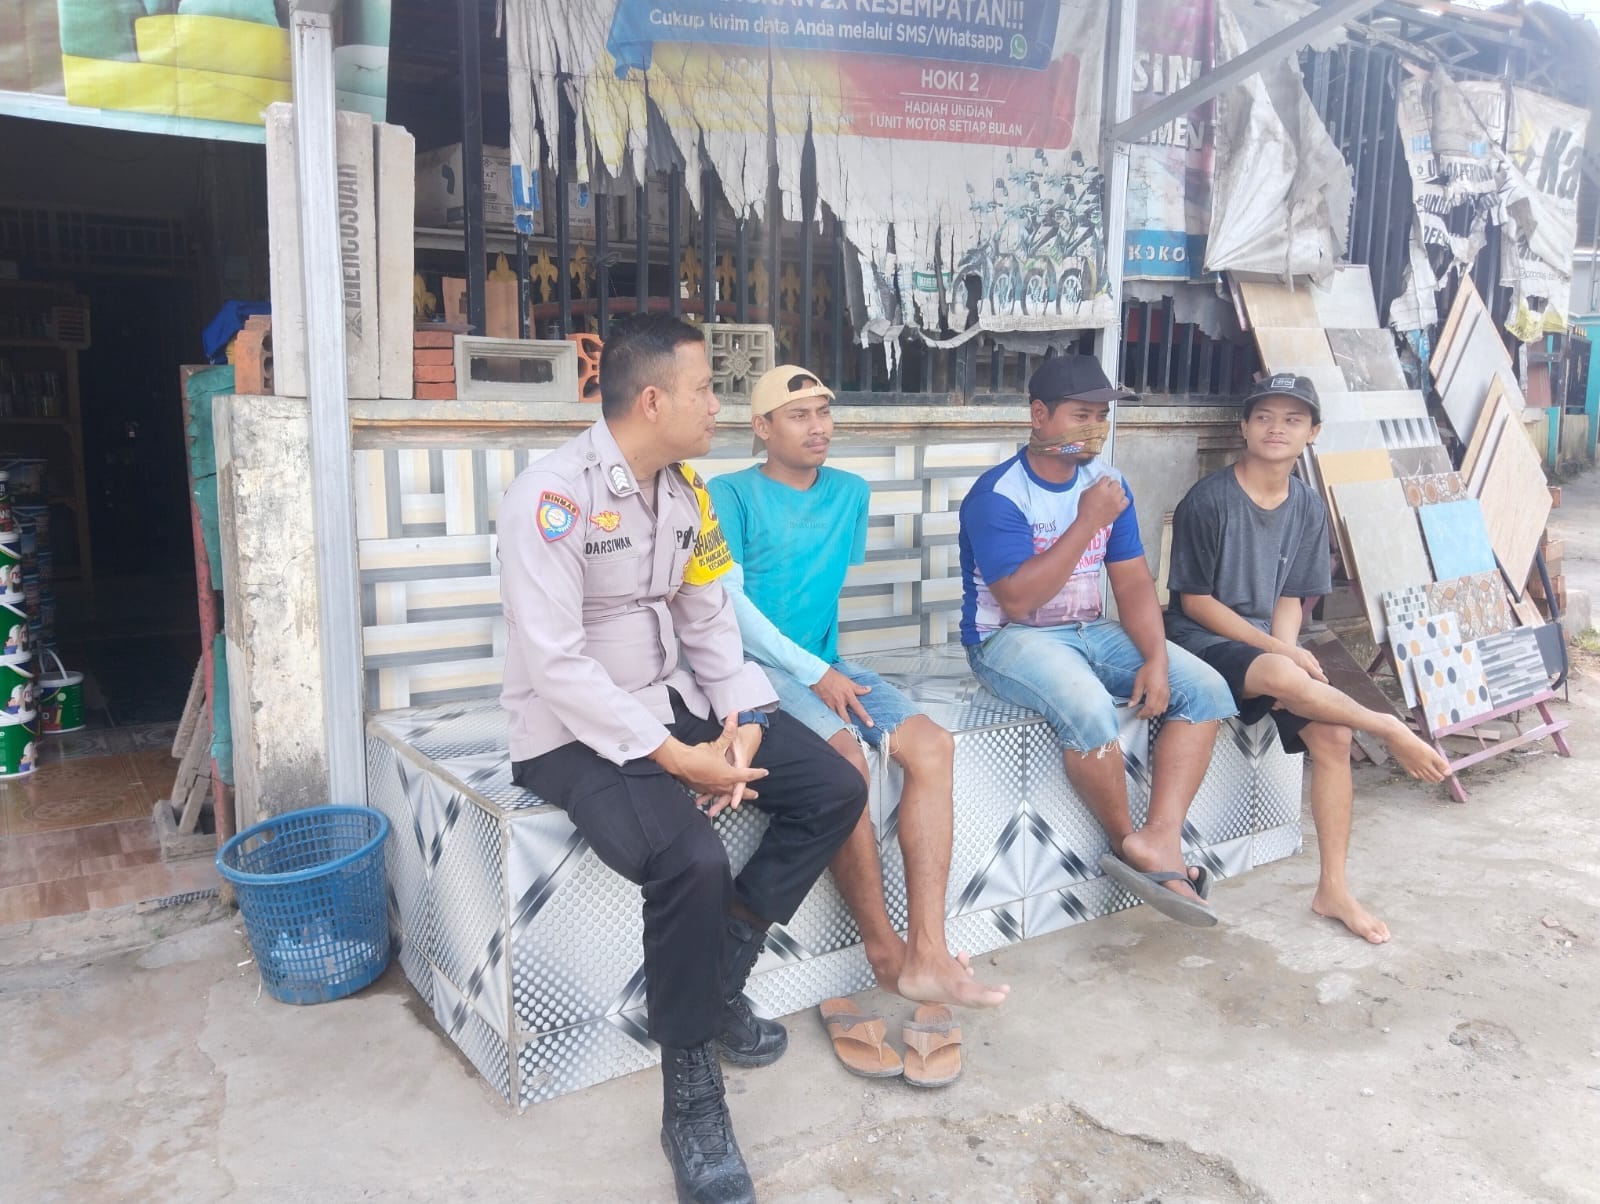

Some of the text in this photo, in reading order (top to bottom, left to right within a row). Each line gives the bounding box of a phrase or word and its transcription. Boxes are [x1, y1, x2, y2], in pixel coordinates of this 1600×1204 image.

[650, 9, 1003, 53] Cukup kirim data Anda melalui SMS/Whatsapp
[921, 68, 980, 92] HOKI 2
[904, 101, 993, 118] HADIAH UNDIAN
[876, 115, 903, 129] UNIT
[906, 117, 946, 131] MOTOR
[949, 119, 986, 134] SETIAP
[989, 122, 1023, 136] BULAN
[585, 536, 632, 555] DARSIWAN
